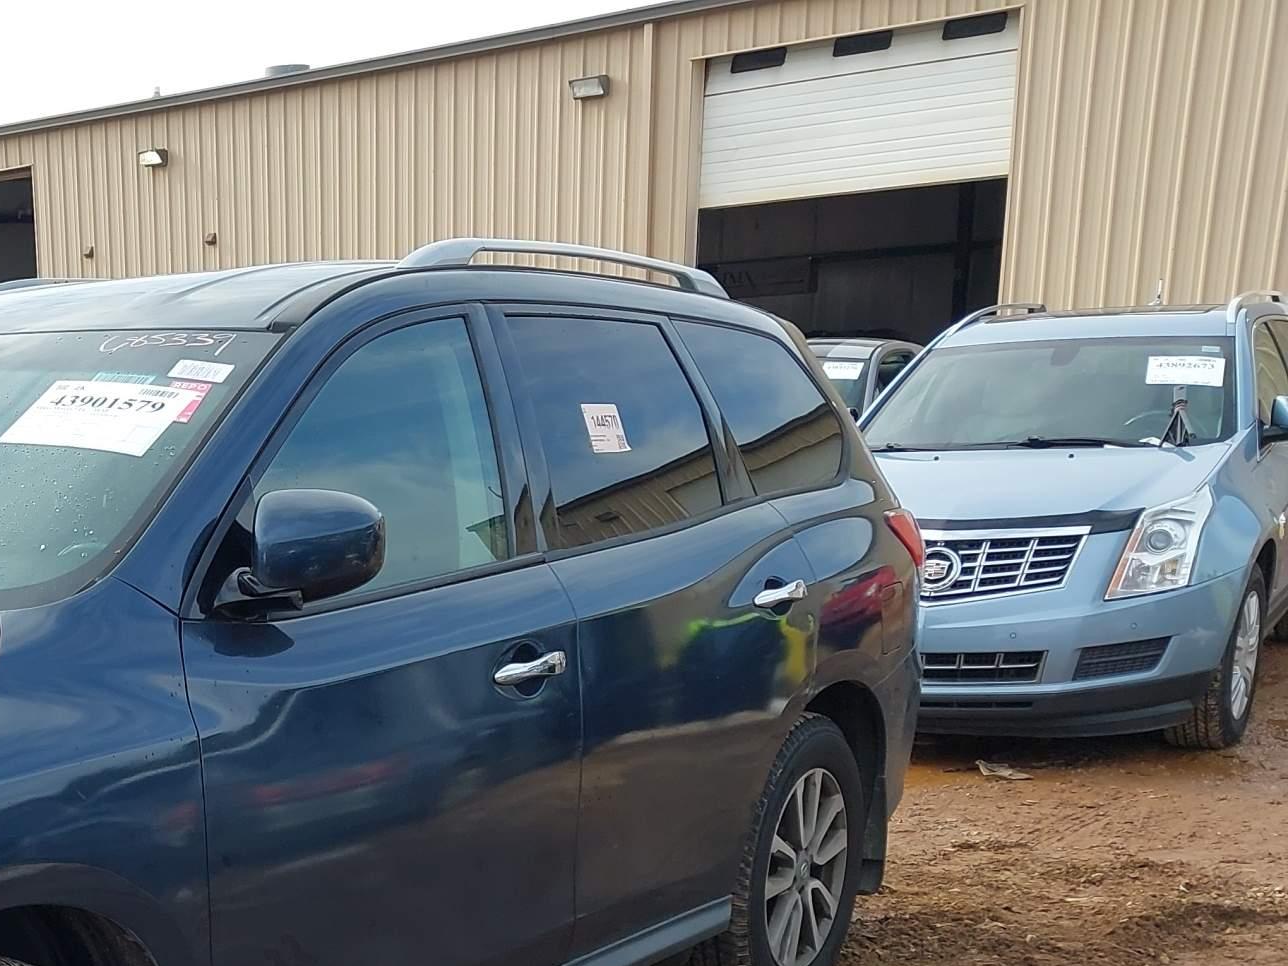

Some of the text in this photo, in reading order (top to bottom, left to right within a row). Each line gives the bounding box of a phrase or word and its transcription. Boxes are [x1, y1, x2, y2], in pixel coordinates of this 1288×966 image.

[173, 380, 208, 391] REPO
[50, 395, 166, 413] 43901579
[591, 415, 620, 429] 144570
